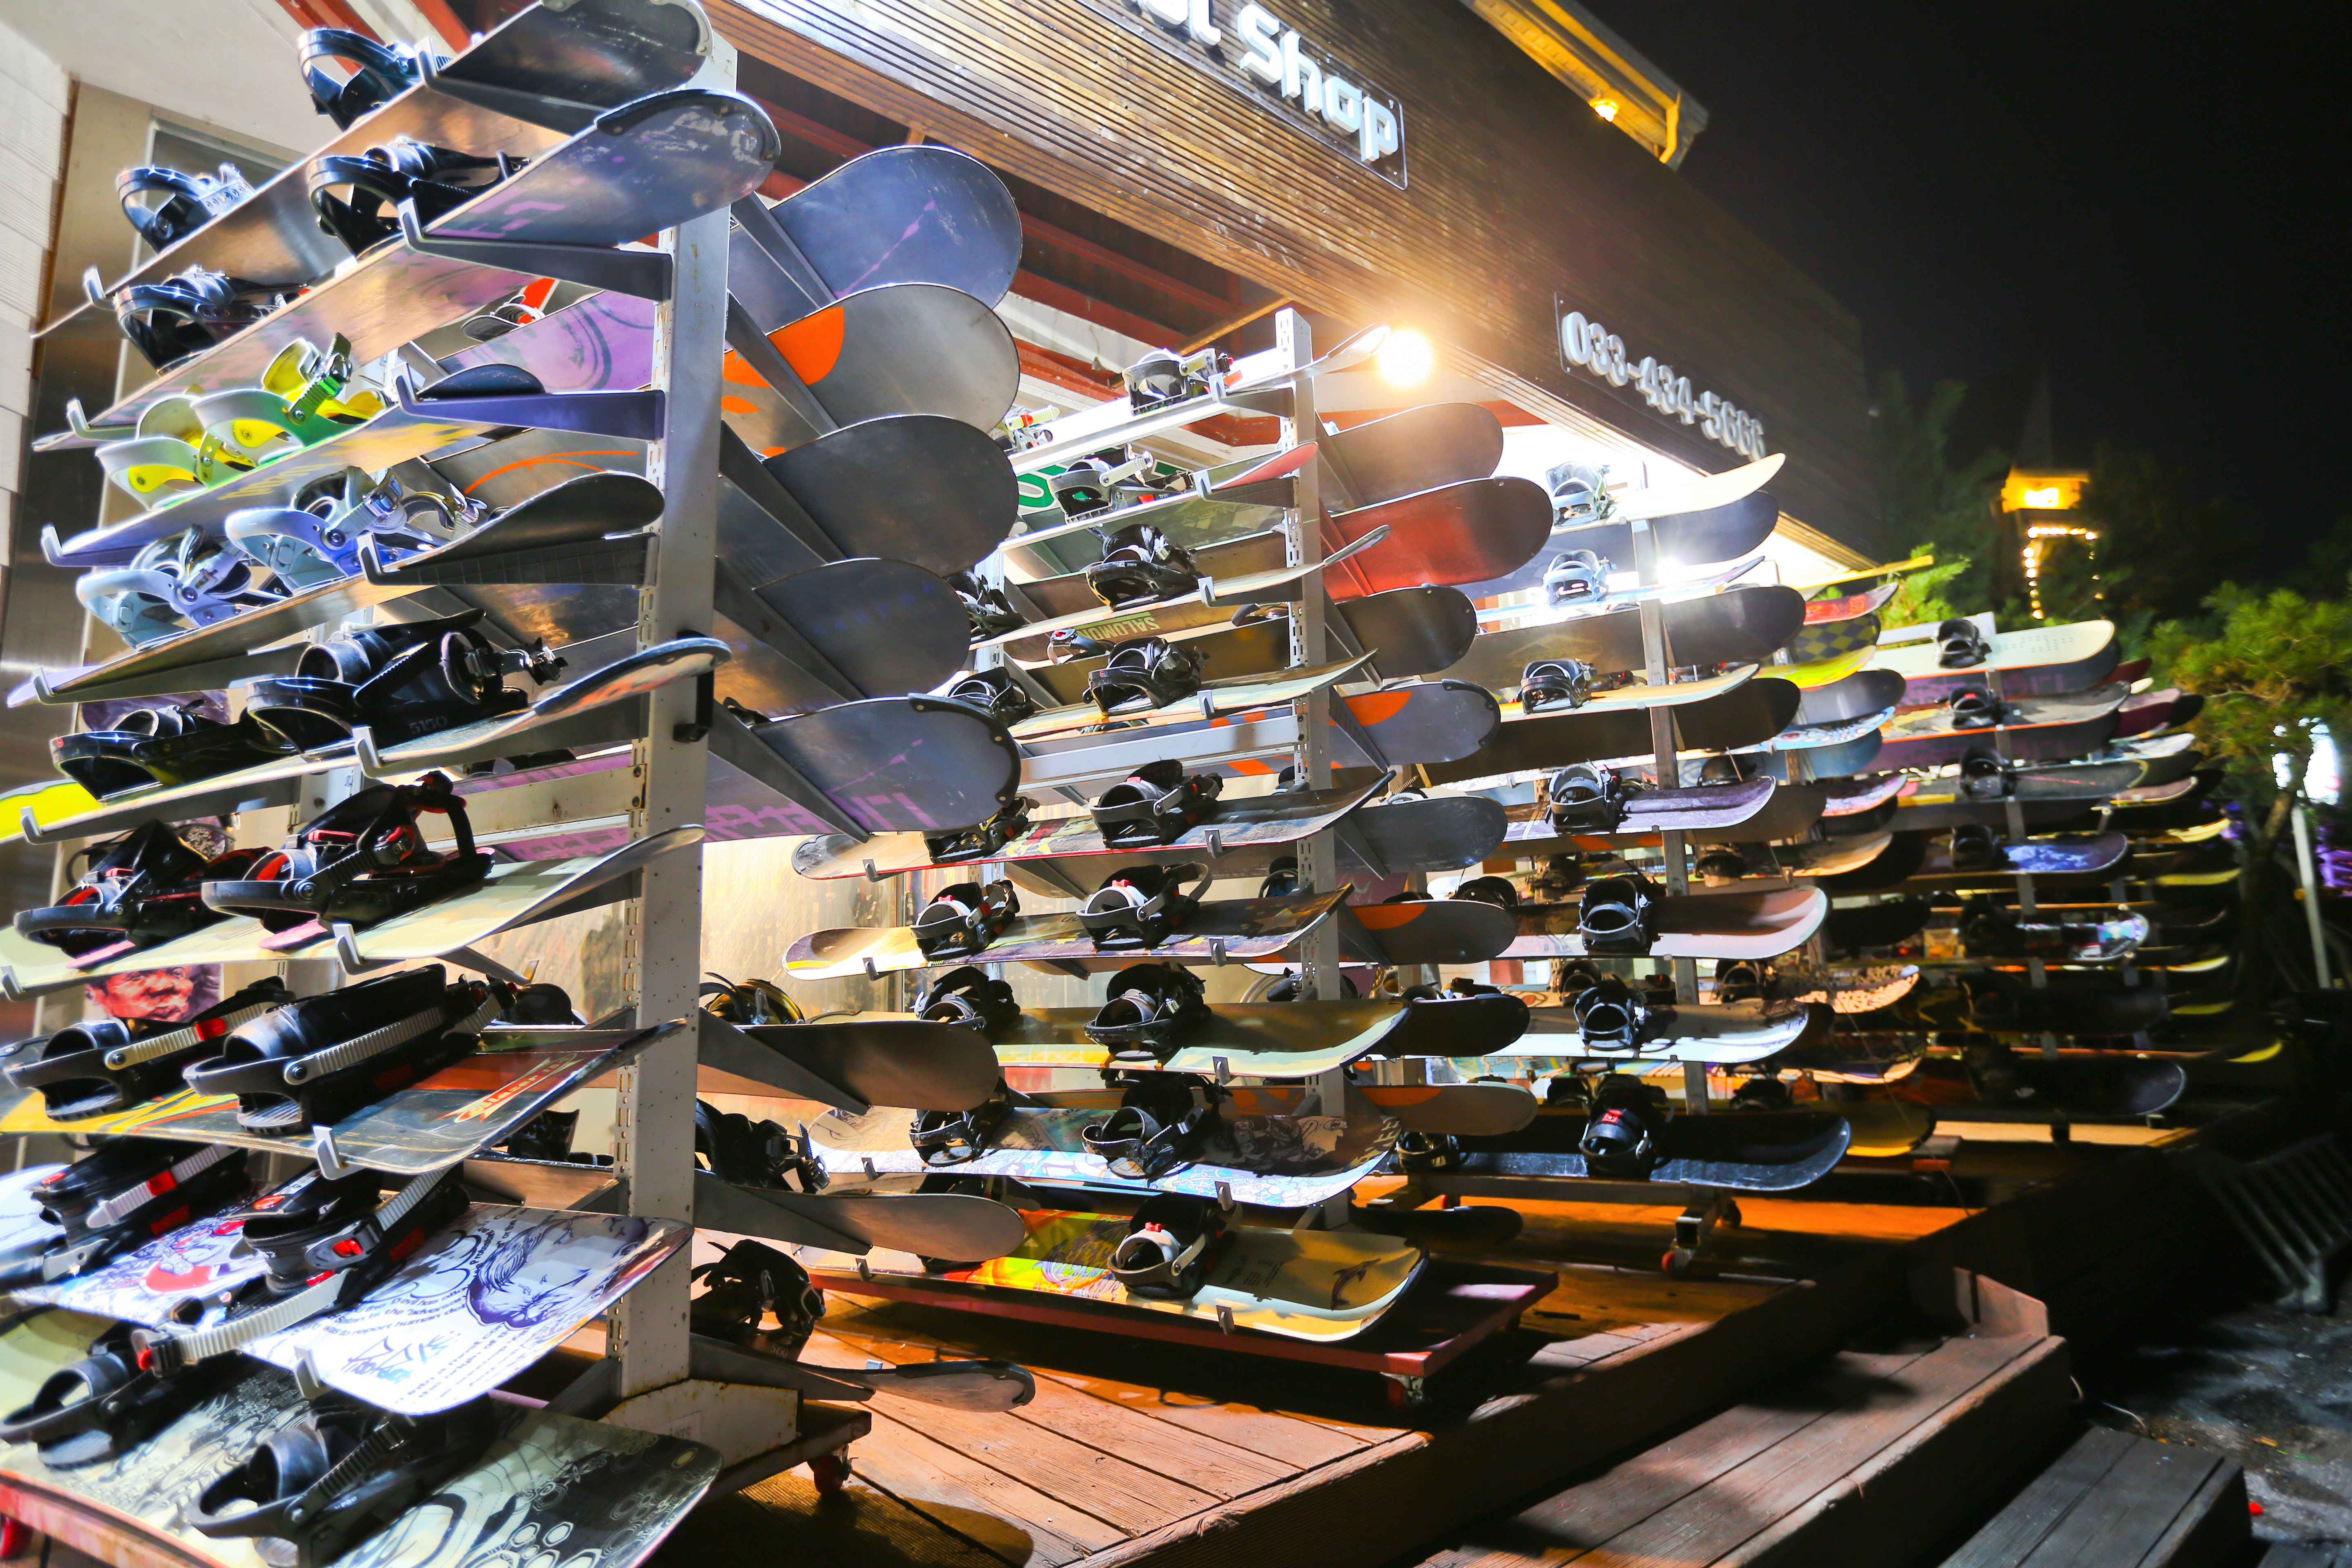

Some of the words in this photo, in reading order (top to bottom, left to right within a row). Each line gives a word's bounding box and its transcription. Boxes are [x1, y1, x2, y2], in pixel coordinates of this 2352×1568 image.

[1238, 3, 1399, 163] Shop
[1562, 311, 1766, 462] 033-434-5666
[409, 716, 448, 735] 5150
[469, 1075, 538, 1117] Blazer
[390, 1297, 419, 1306] Devil
[394, 1313, 441, 1327] human
